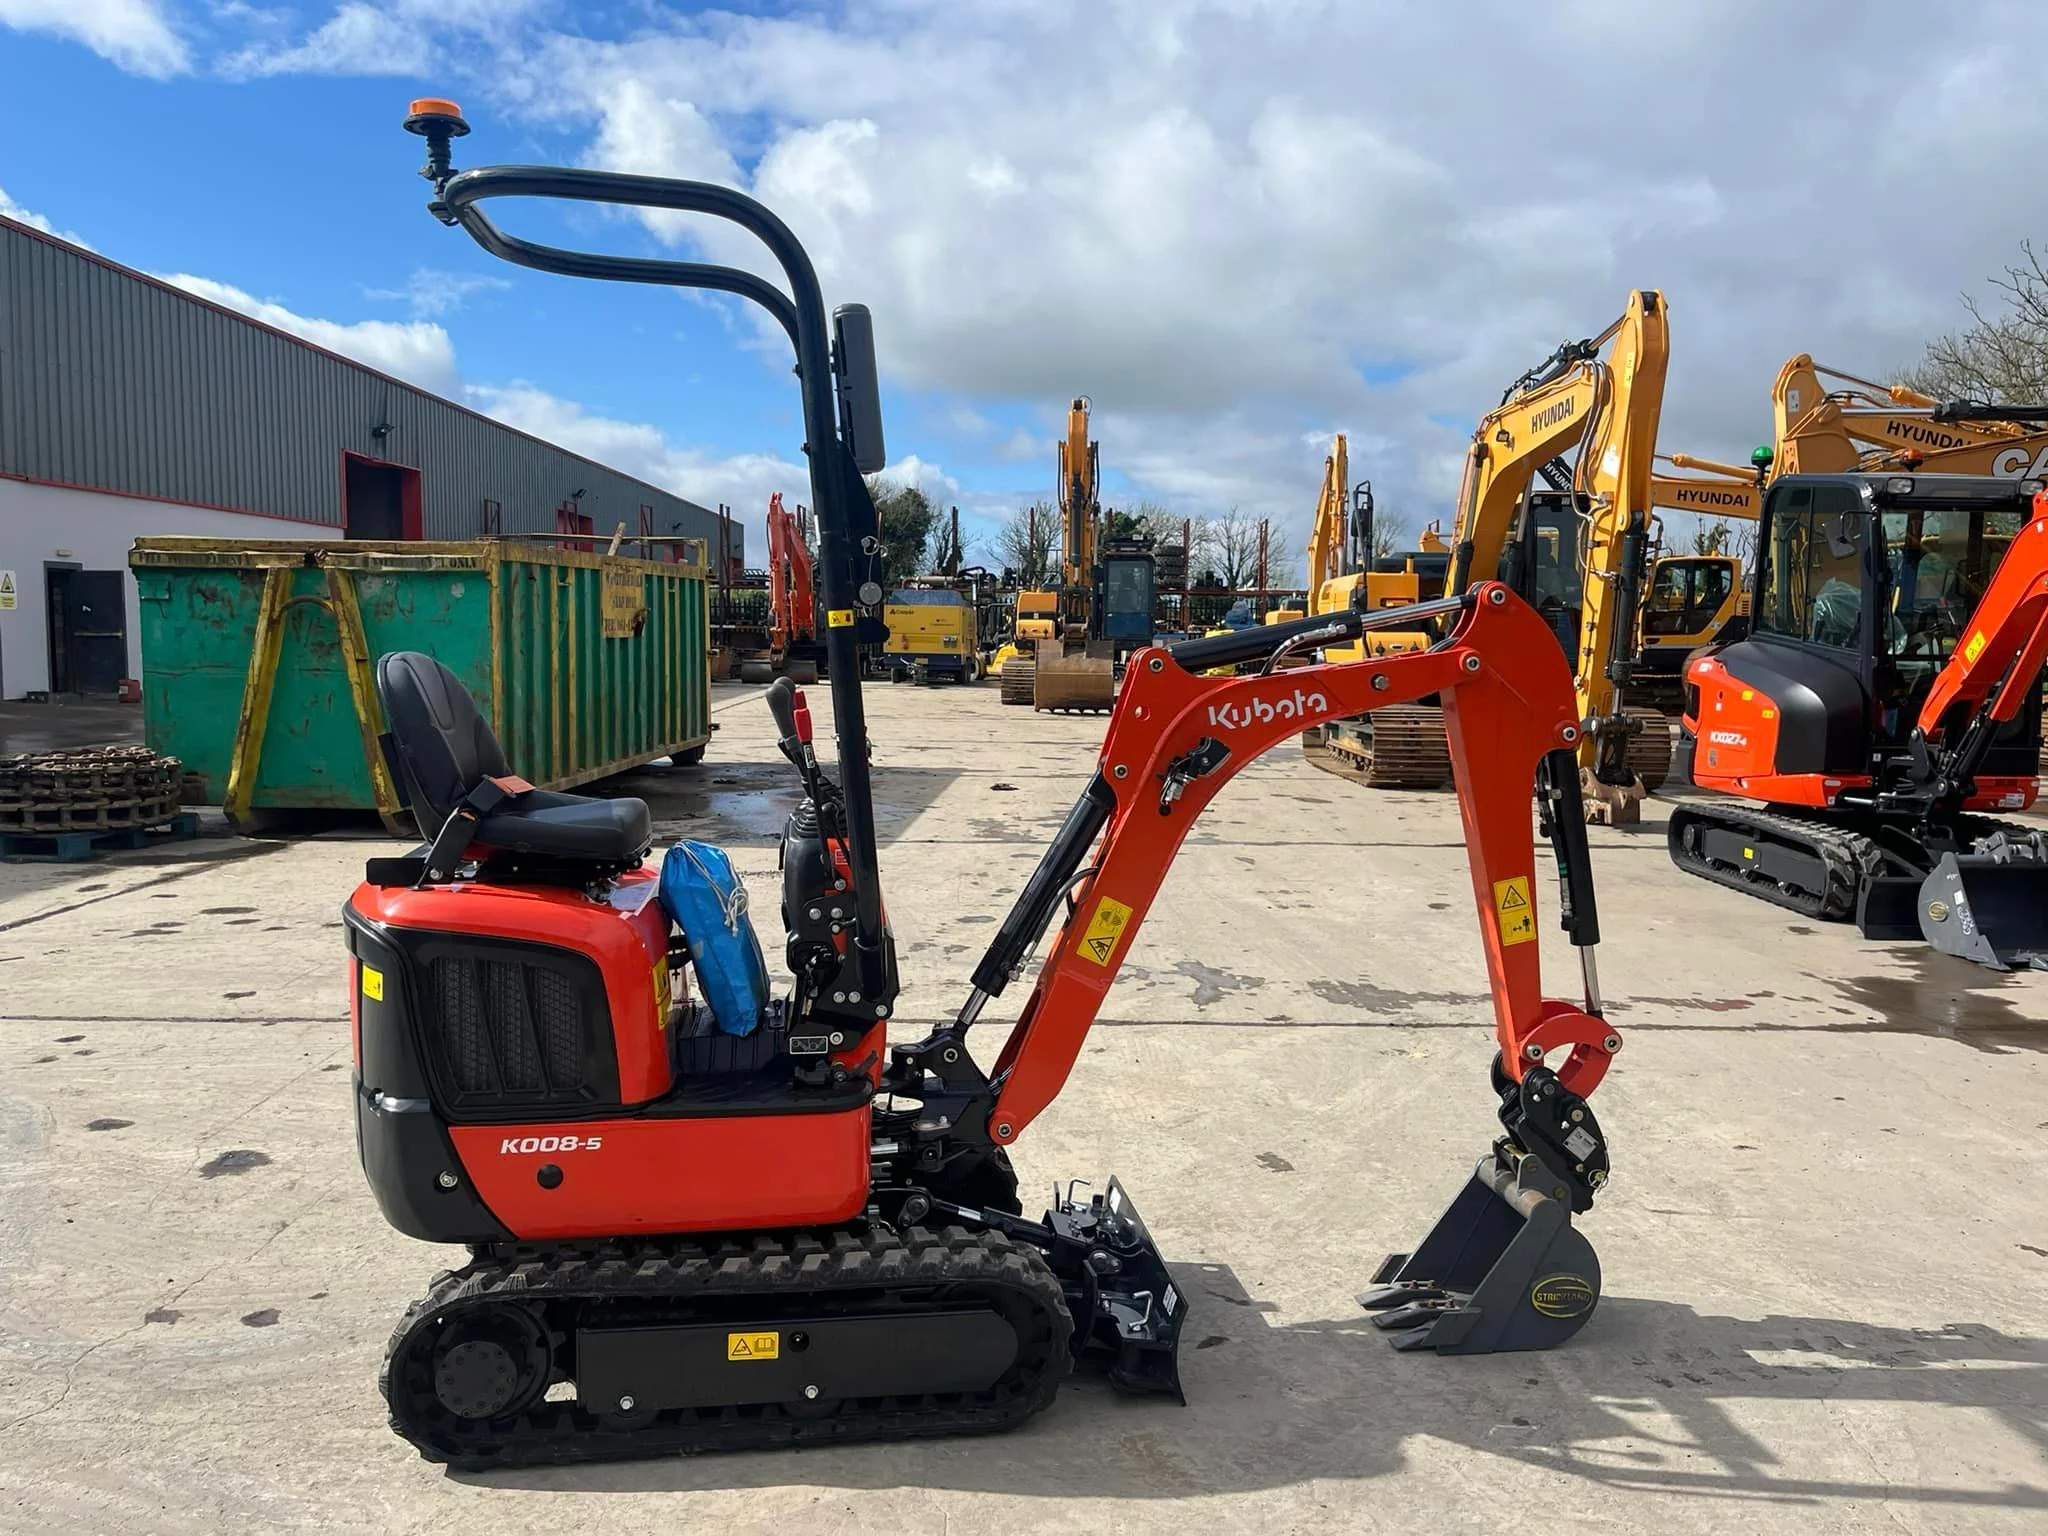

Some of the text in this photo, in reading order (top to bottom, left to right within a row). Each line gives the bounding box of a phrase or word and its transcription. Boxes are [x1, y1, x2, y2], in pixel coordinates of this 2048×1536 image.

[1531, 395, 1575, 434] HYUNDAI
[1887, 420, 1972, 449] HYUNDA
[1677, 489, 1749, 507] HYUNDAI
[1208, 689, 1328, 729] Kubota
[500, 1136, 602, 1154] K008-5
